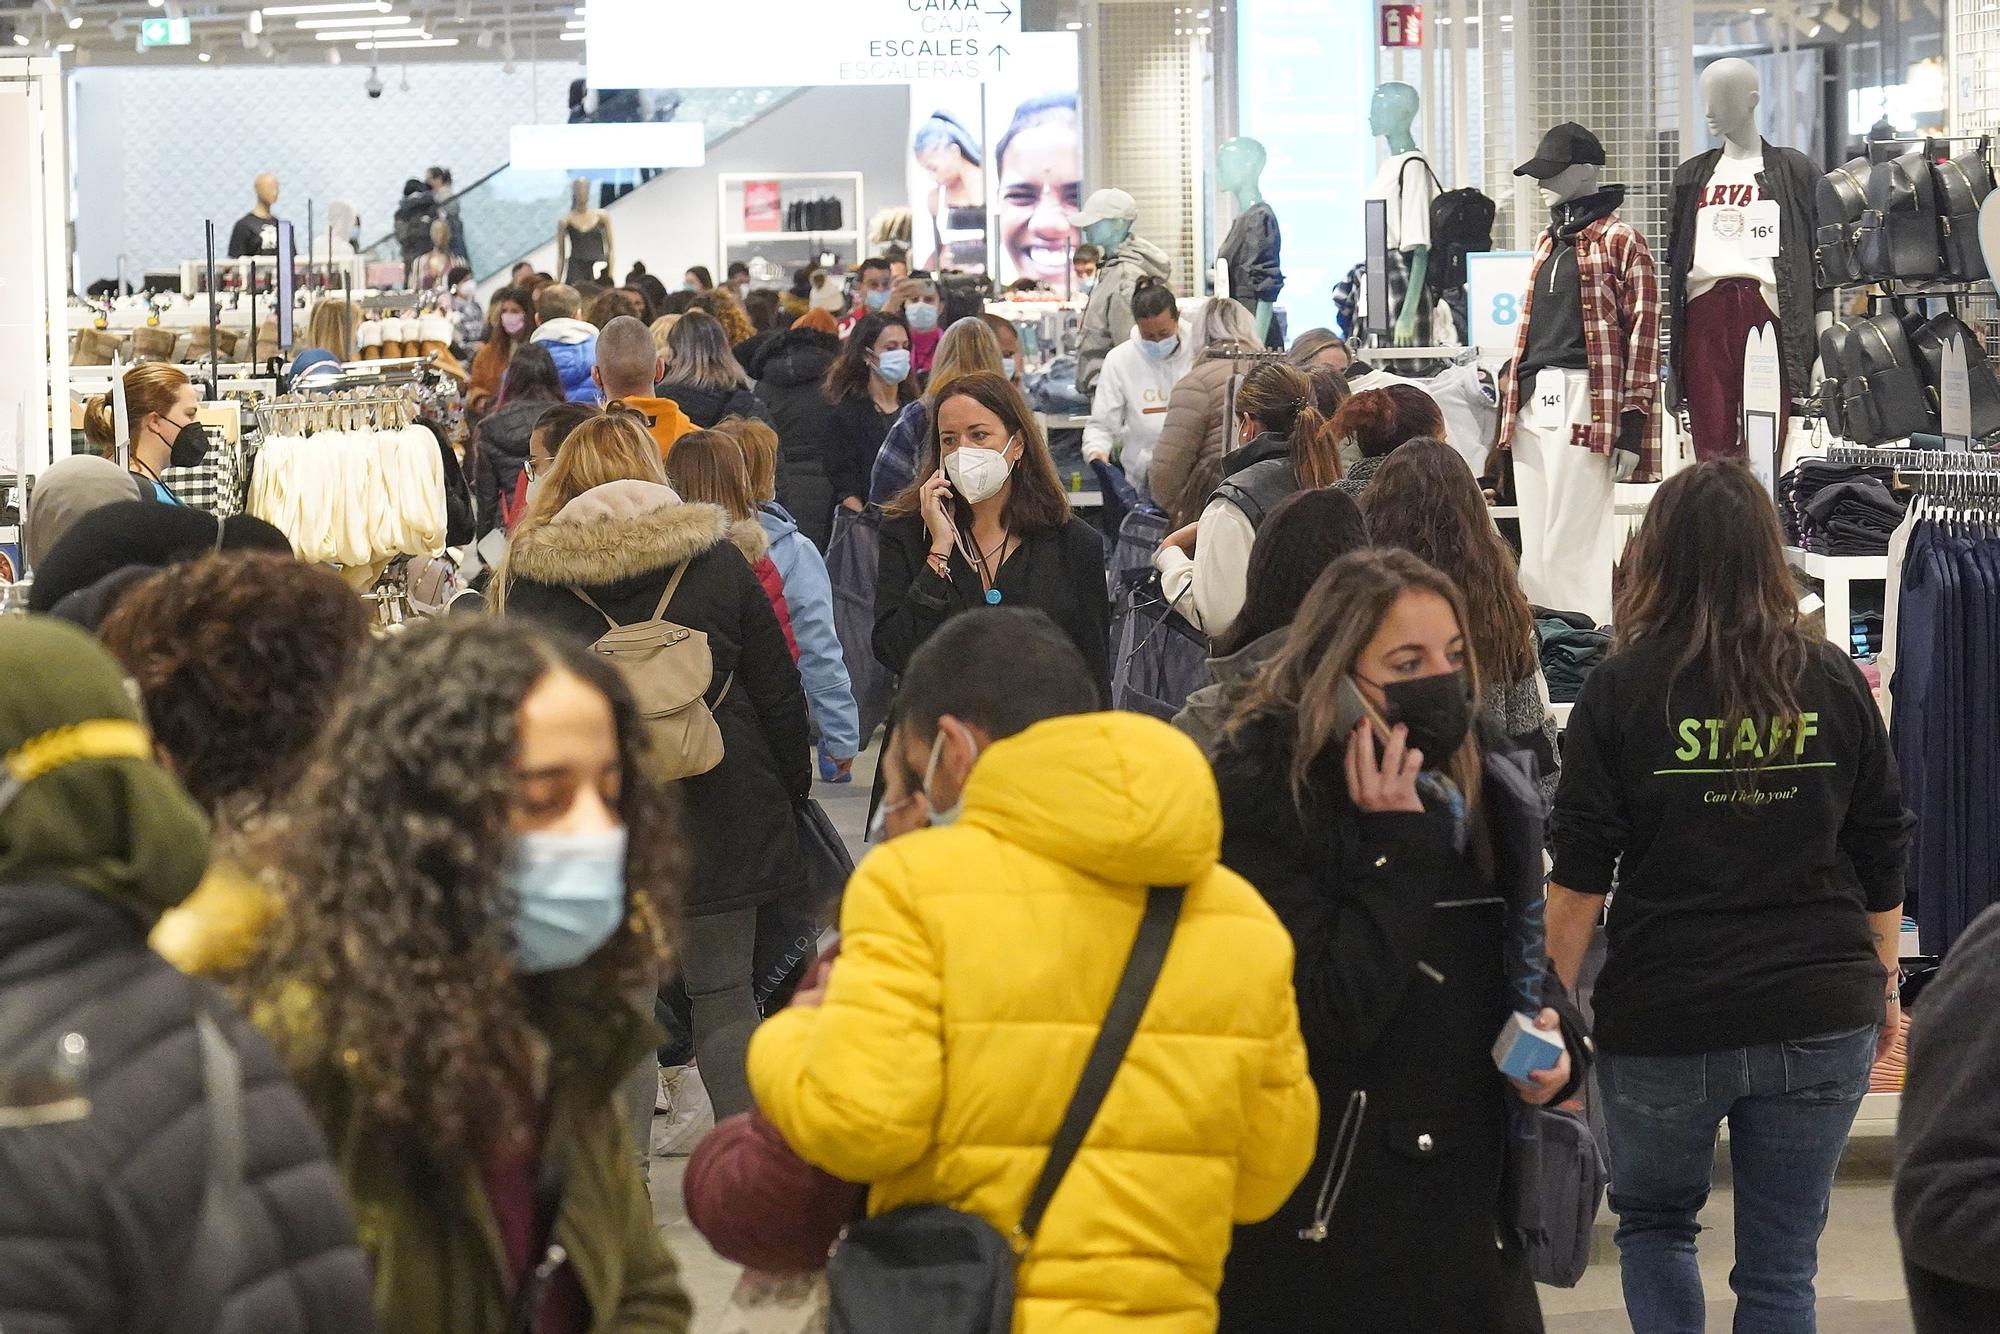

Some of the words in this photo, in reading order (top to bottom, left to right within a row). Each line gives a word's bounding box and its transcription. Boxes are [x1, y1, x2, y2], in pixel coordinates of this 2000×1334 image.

[908, 0, 979, 11] CAIXA
[922, 16, 981, 33] CAJA
[870, 39, 979, 57] ESCALES
[839, 60, 980, 79] ESCALERAS
[1750, 225, 1774, 238] 16€
[1541, 395, 1561, 407] 14€
[1570, 423, 1592, 447] H
[1675, 712, 1818, 761] STAFF
[1704, 790, 1727, 803] Can
[1767, 786, 1797, 804] you?
